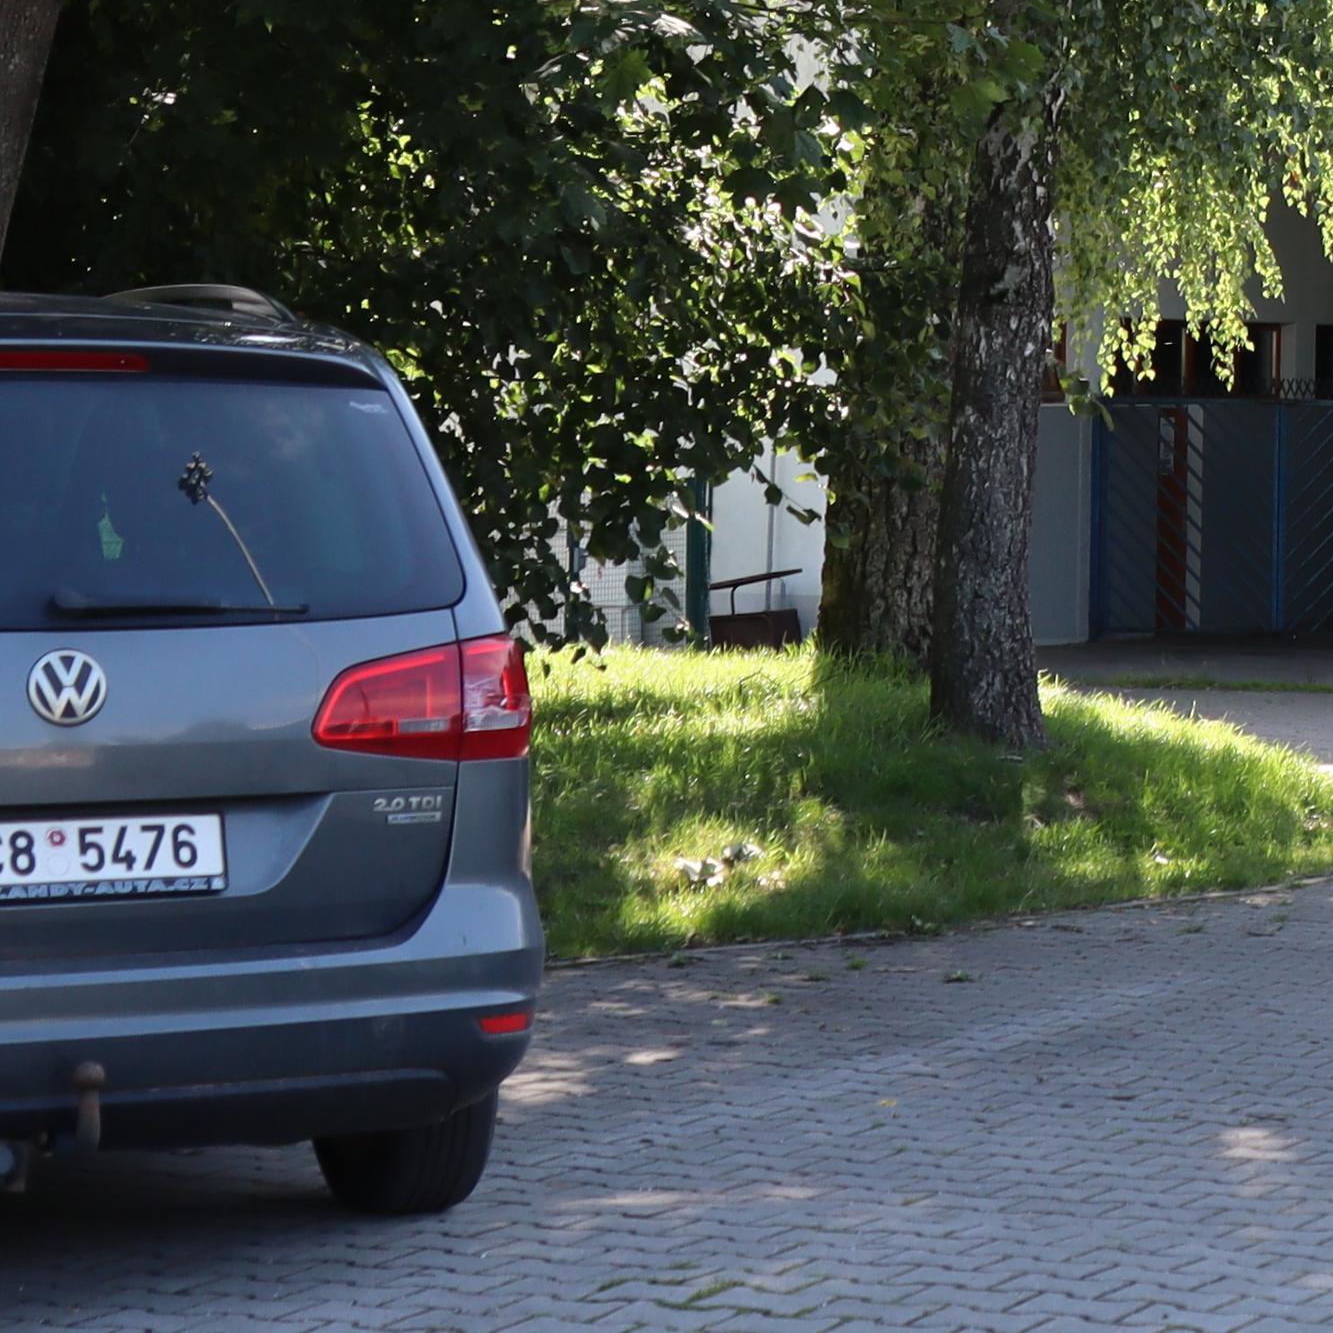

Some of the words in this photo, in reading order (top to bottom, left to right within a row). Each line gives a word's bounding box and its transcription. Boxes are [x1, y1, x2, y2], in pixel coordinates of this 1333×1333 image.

[408, 794, 443, 810] TDI
[0, 830, 36, 876] 8
[78, 823, 198, 873] 5476
